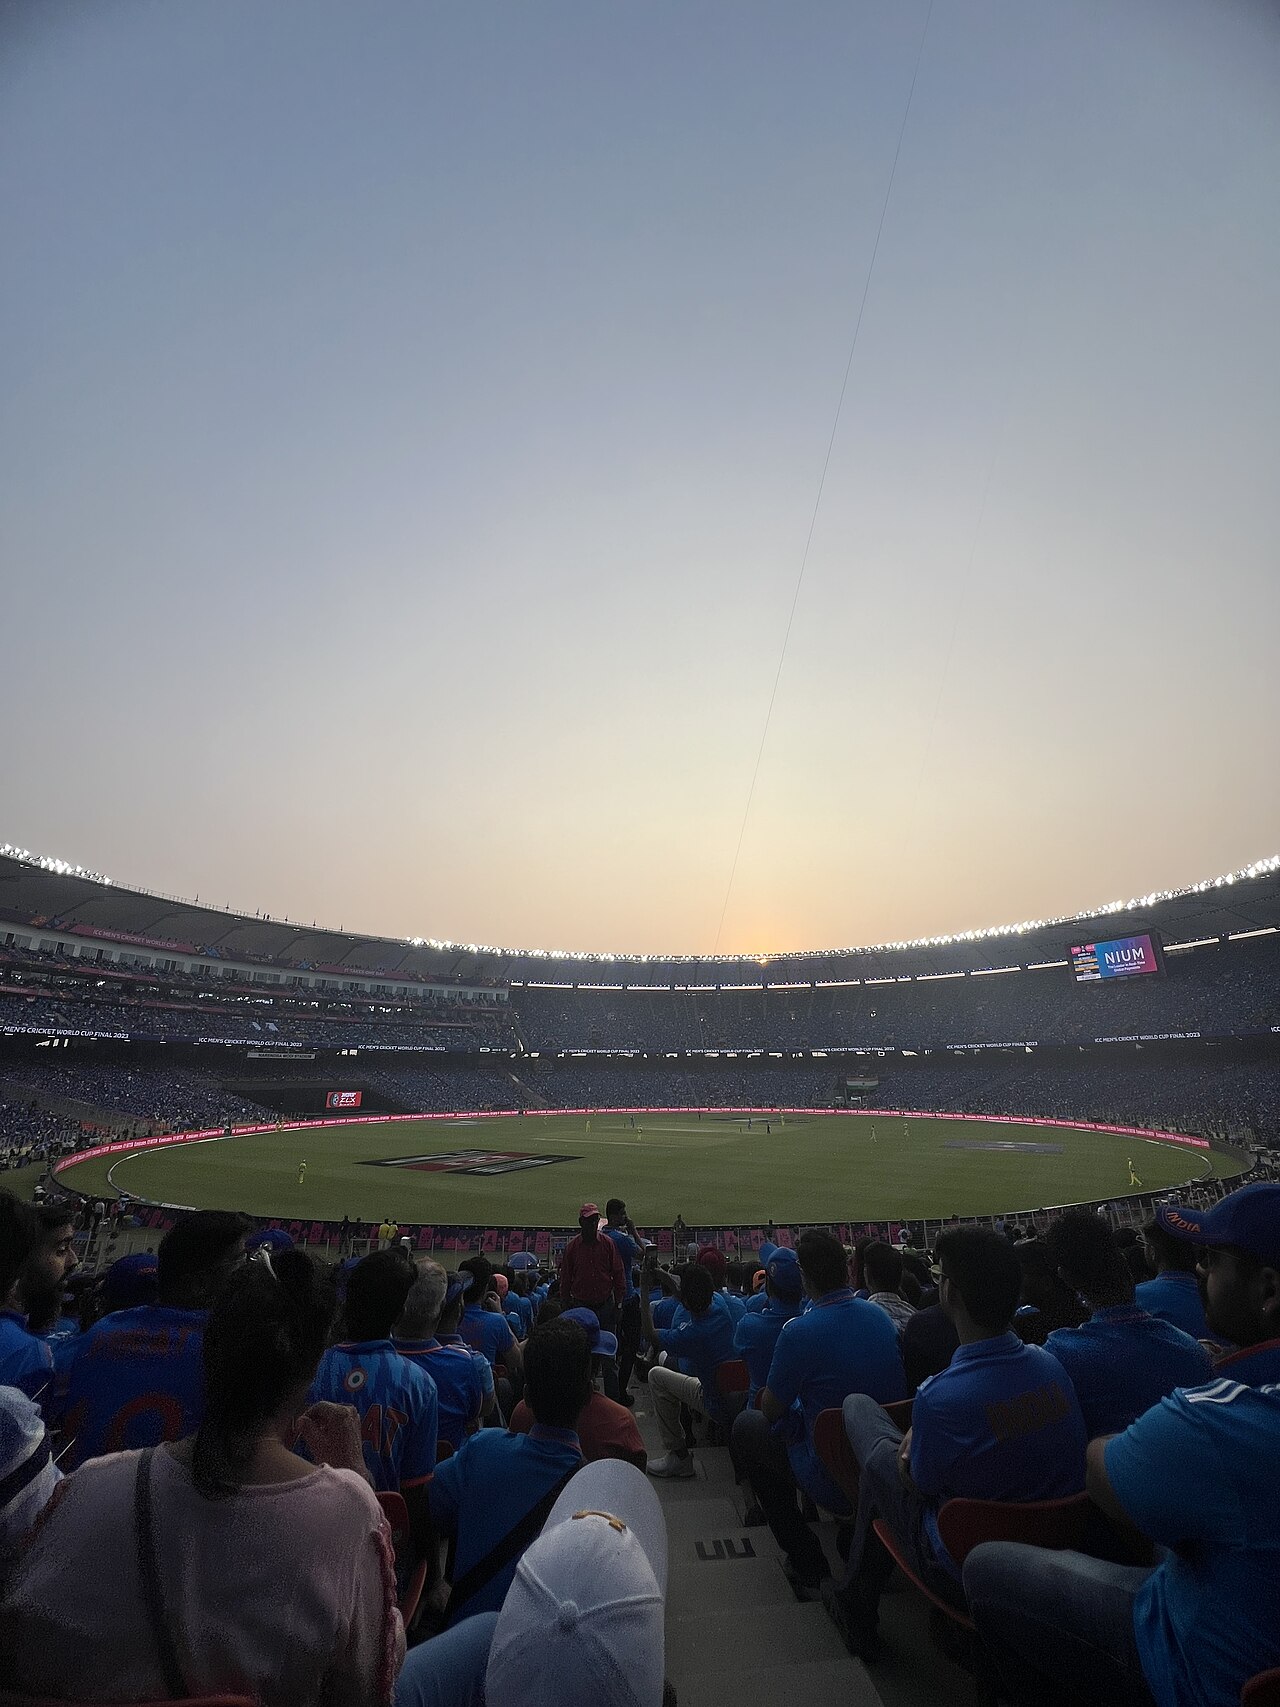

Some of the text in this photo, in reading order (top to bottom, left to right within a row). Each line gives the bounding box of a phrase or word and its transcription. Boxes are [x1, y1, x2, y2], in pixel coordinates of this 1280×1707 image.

[145, 938, 166, 946] WORLD
[1104, 947, 1144, 964] NIUM
[27, 1027, 55, 1035] CRICKET
[1167, 1212, 1200, 1232] INDIA
[984, 1380, 1071, 1441] INDIA
